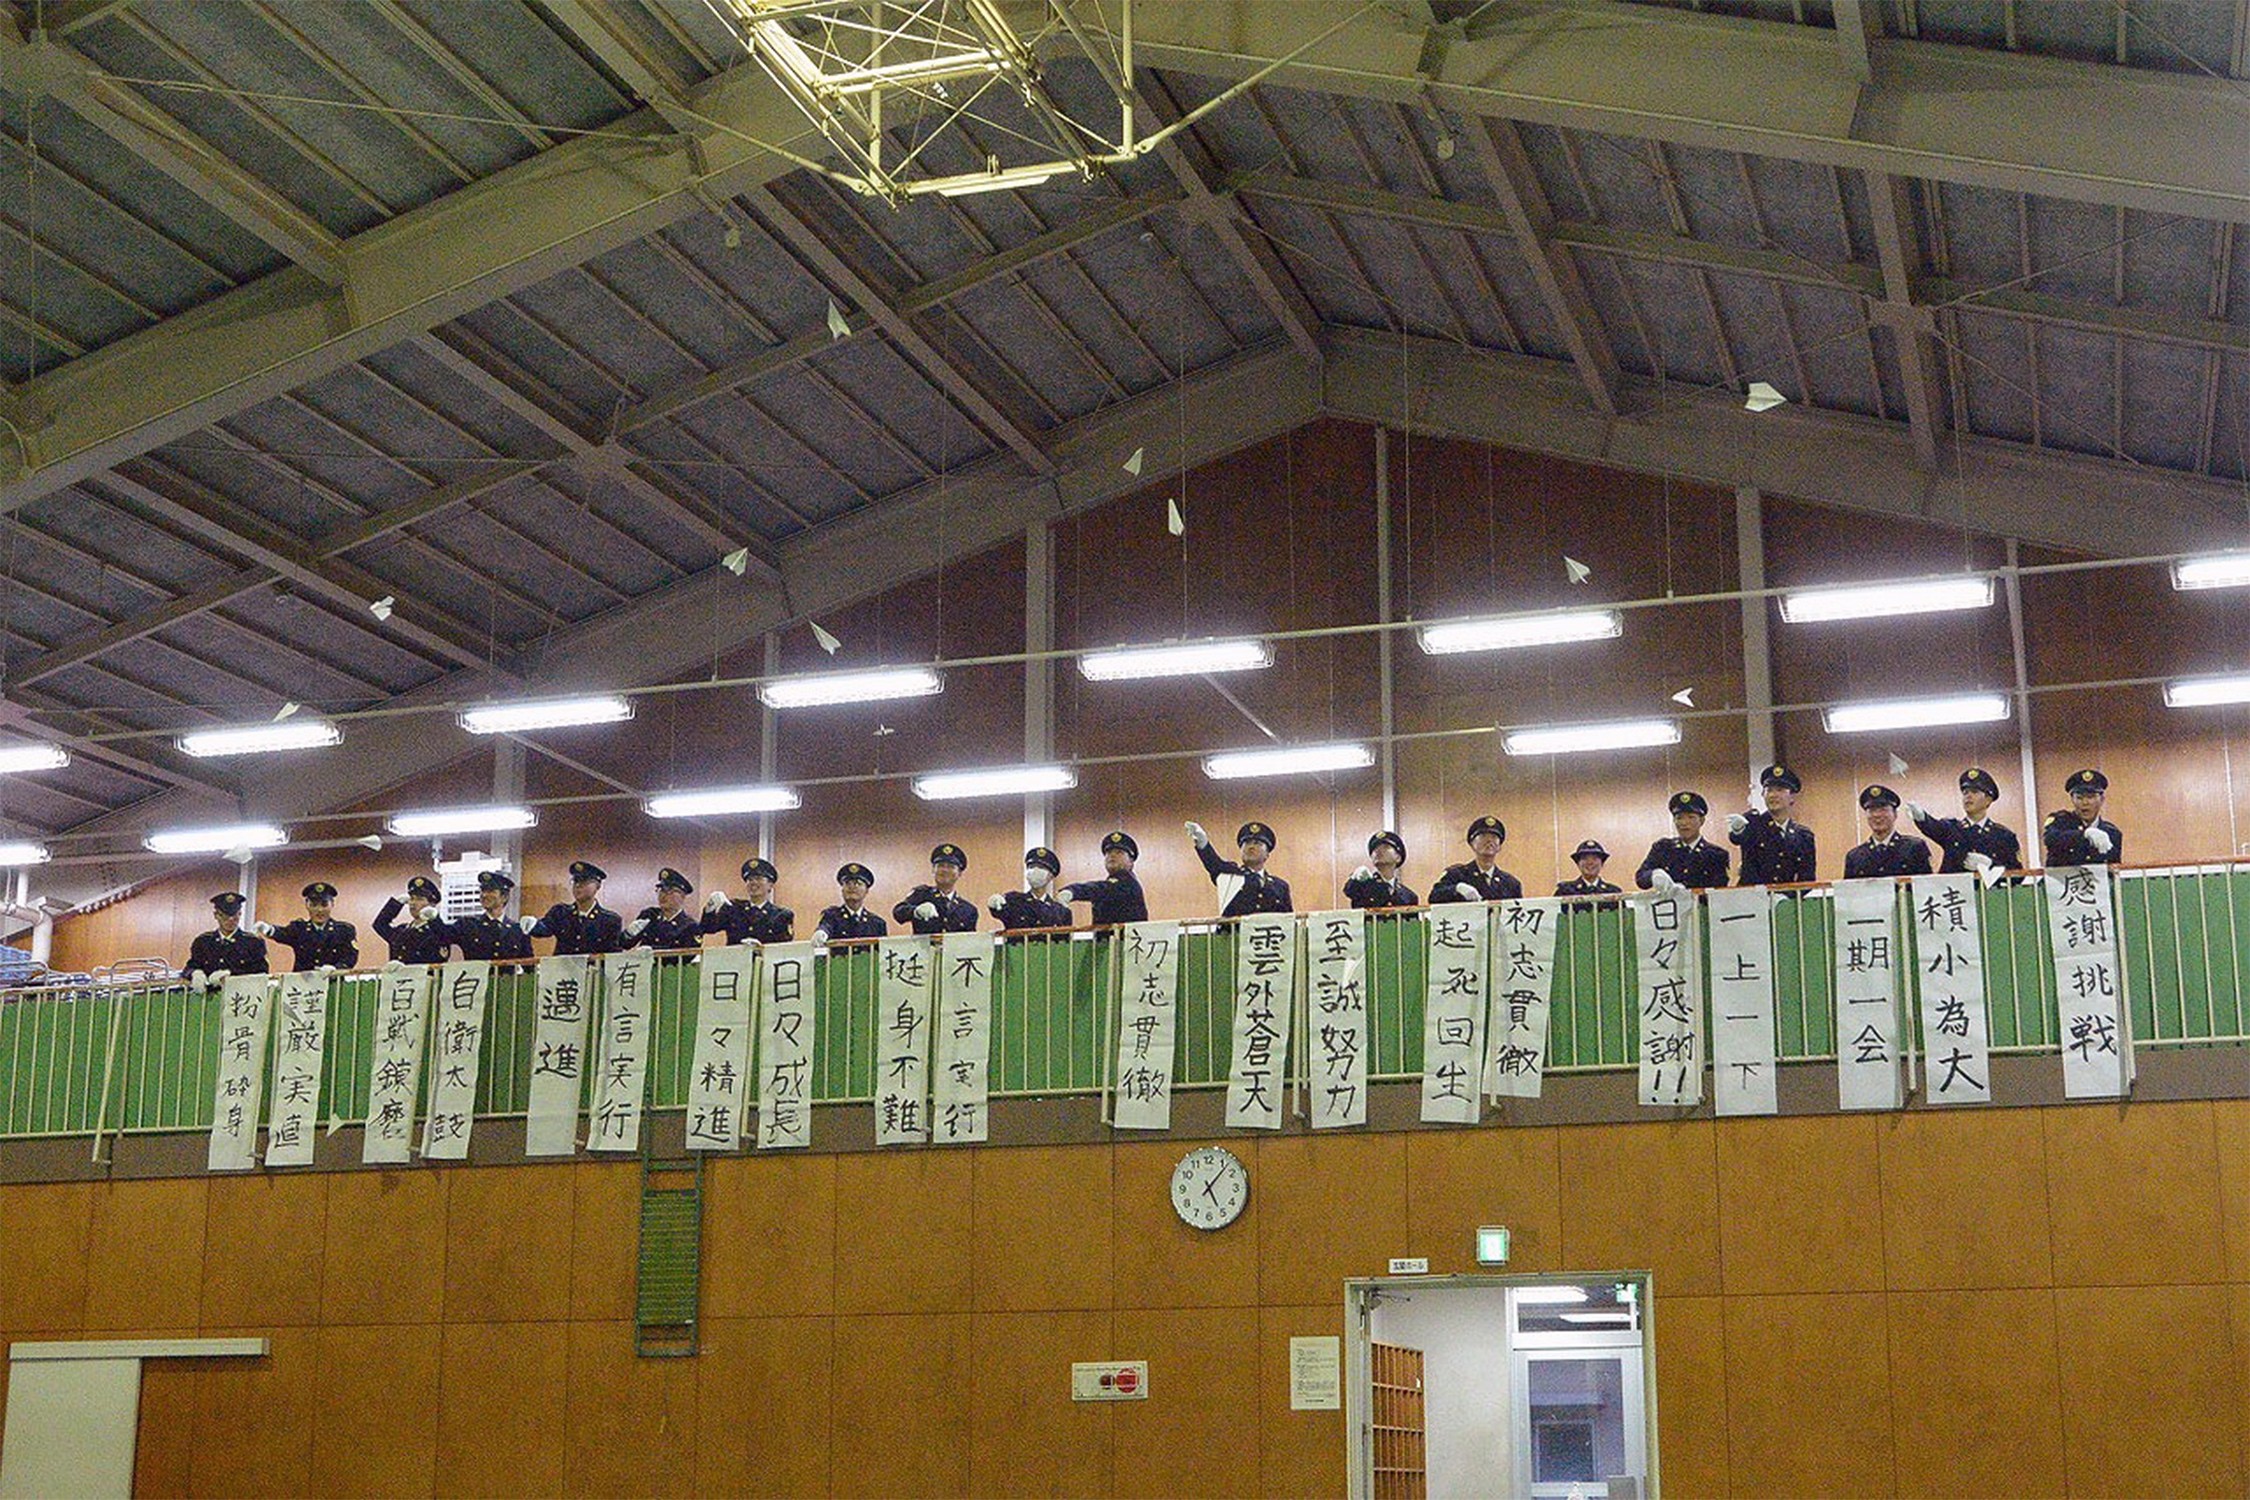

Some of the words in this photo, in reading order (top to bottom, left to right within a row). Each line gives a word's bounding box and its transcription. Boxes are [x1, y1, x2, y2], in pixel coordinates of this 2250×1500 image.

[533, 978, 581, 1080] 邁進
[882, 948, 926, 1136] 挺身不難
[942, 955, 985, 1138] 不言実行
[1120, 929, 1170, 1104] 初志貫徹
[1238, 925, 1286, 1114] 雲外蒼天
[1316, 919, 1363, 1120] 至誠努力
[1431, 917, 1479, 1105] 起死回生
[1495, 899, 1545, 1078] 初志貫徹
[1719, 911, 1760, 1090] 一上一下
[1845, 918, 1891, 1065] 一期一会
[1917, 884, 1985, 1094] 積小為大
[2058, 866, 2119, 1064] 感謝挑戦
[273, 987, 326, 1150] 謹厳実直
[432, 969, 481, 1144] 自衛太鼓
[597, 961, 642, 1140] 有言実行
[690, 971, 739, 1144] 日々精進
[765, 959, 809, 1145] 日々成長
[1179, 1185, 1186, 1194] 9
[1183, 1170, 1193, 1179] 10
[1184, 1199, 1190, 1208] 8
[1191, 1160, 1200, 1168] 11
[1194, 1208, 1199, 1216] 7
[1204, 1155, 1214, 1164] 12
[1206, 1212, 1213, 1221] 6
[1220, 1208, 1227, 1217] 5
[1228, 1169, 1236, 1178] 2
[1228, 1197, 1235, 1206] 4
[1233, 1183, 1240, 1192] 3
